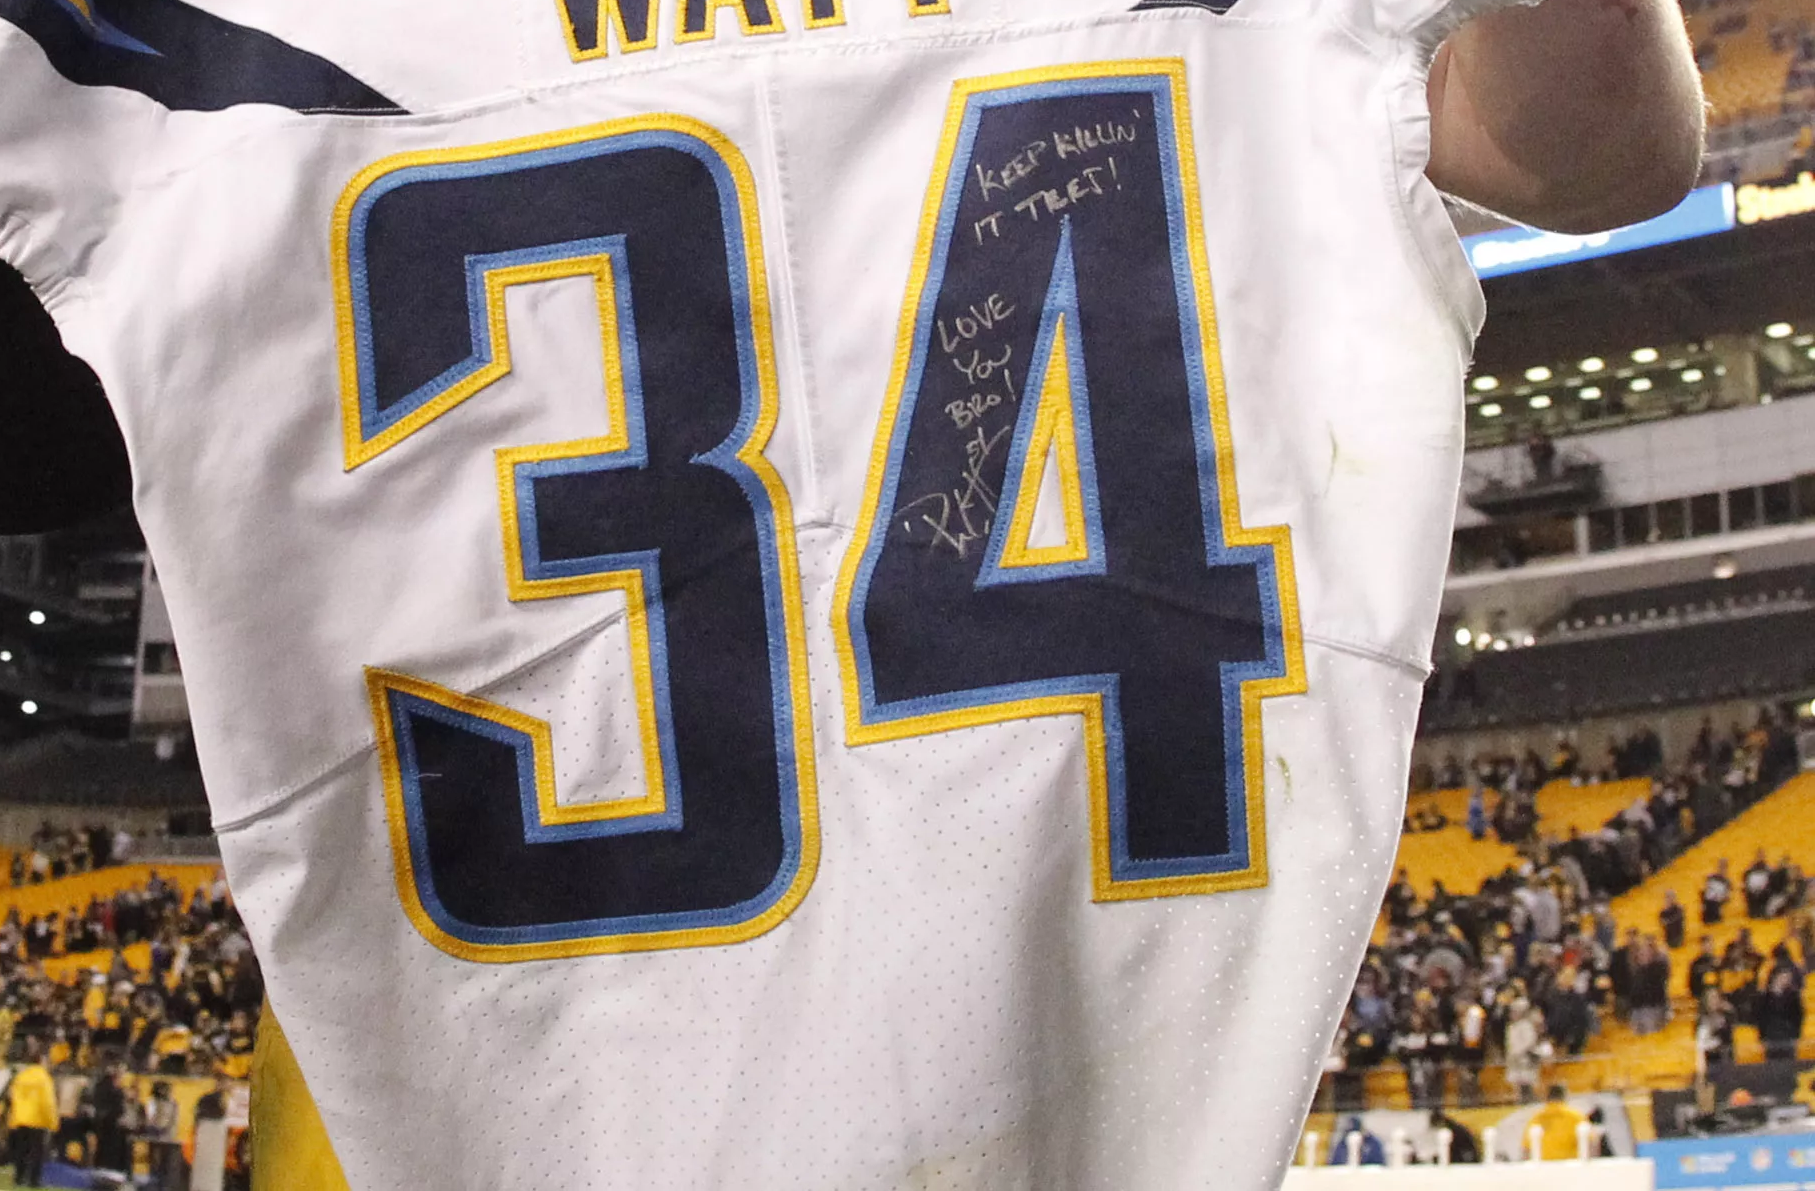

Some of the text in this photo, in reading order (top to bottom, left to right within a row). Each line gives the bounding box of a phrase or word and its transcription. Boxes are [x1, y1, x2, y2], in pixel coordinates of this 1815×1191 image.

[976, 140, 1047, 202] KEEP
[974, 211, 1003, 246] IT
[937, 293, 1016, 353] LOVE
[330, 56, 1309, 964] 34
